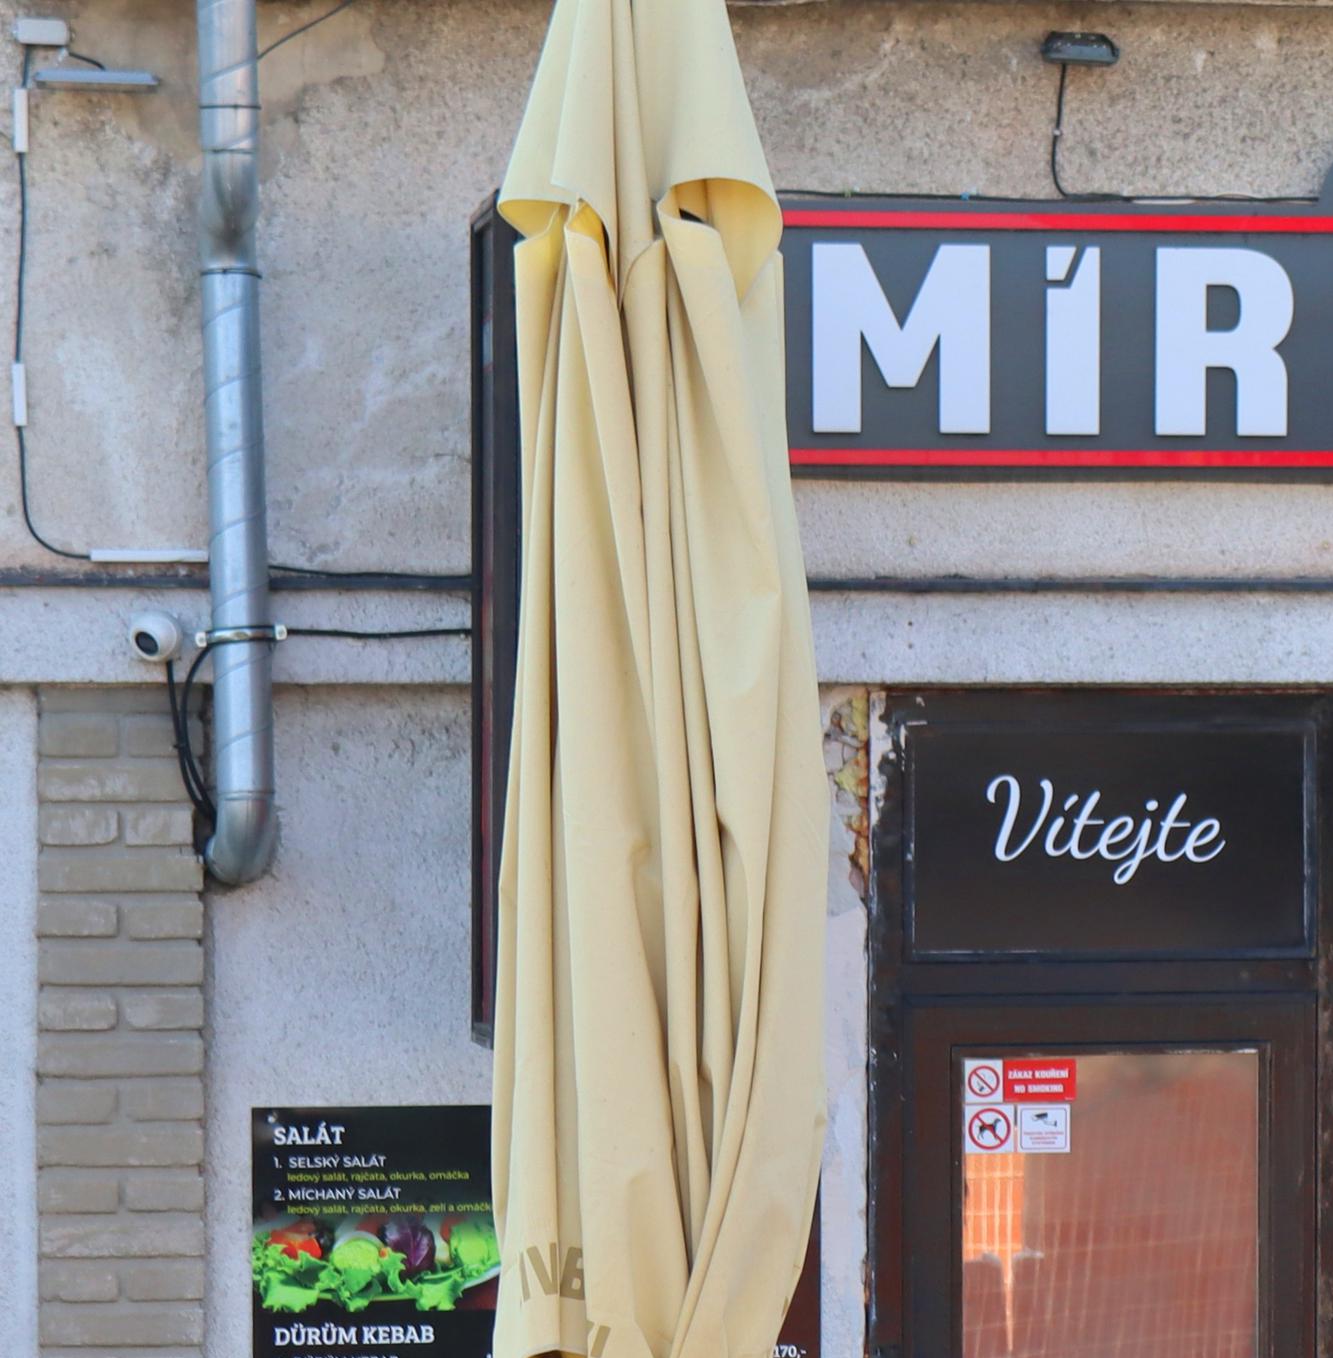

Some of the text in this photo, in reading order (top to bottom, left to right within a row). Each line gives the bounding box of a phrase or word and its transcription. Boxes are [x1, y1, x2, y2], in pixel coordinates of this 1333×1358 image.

[986, 775, 1225, 884] Vítejte
[274, 1122, 345, 1145] SALÁT
[274, 1154, 386, 1169] 1. SELSKÝ SALÁT
[274, 1187, 401, 1200] 2. MÍCHANÝ SALÁT
[274, 1323, 435, 1346] DÜRÜM KEBAB
